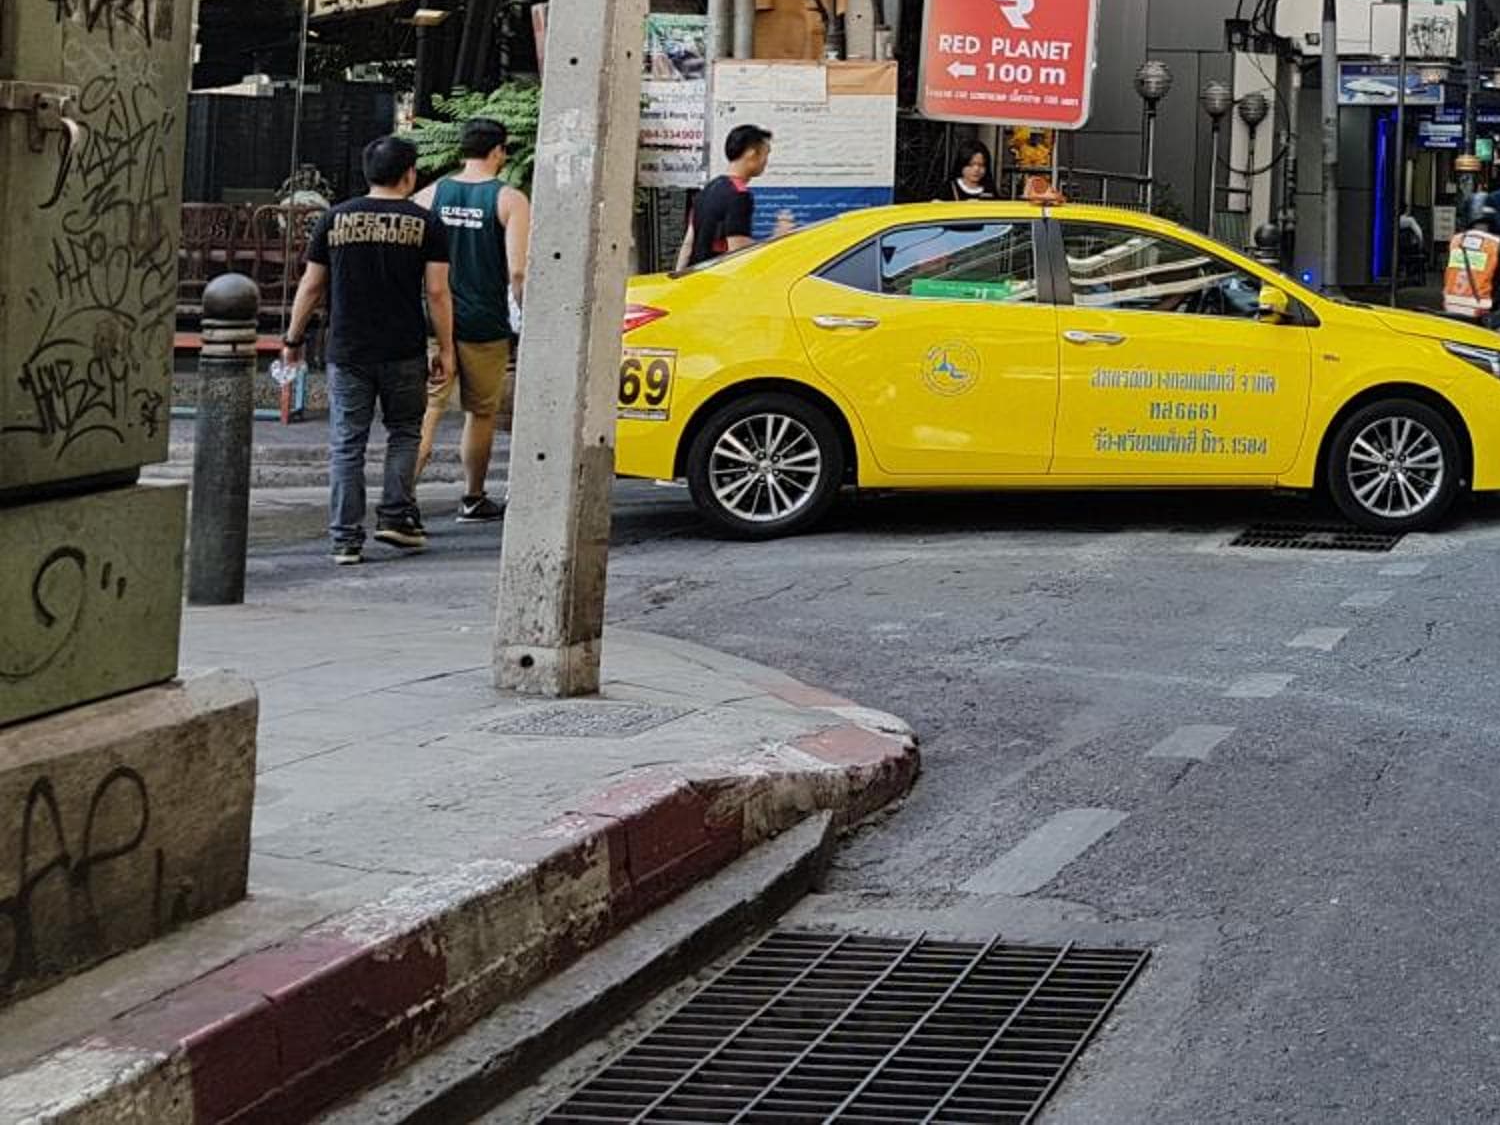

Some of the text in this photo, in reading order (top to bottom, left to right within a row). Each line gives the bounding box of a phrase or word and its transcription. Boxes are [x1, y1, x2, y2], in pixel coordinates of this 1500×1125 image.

[938, 34, 1073, 60] RED PLANET
[985, 62, 1066, 85] 100 m
[333, 212, 426, 233] INFECTED
[328, 226, 426, 247] MUSHROOM
[618, 359, 670, 405] 69
